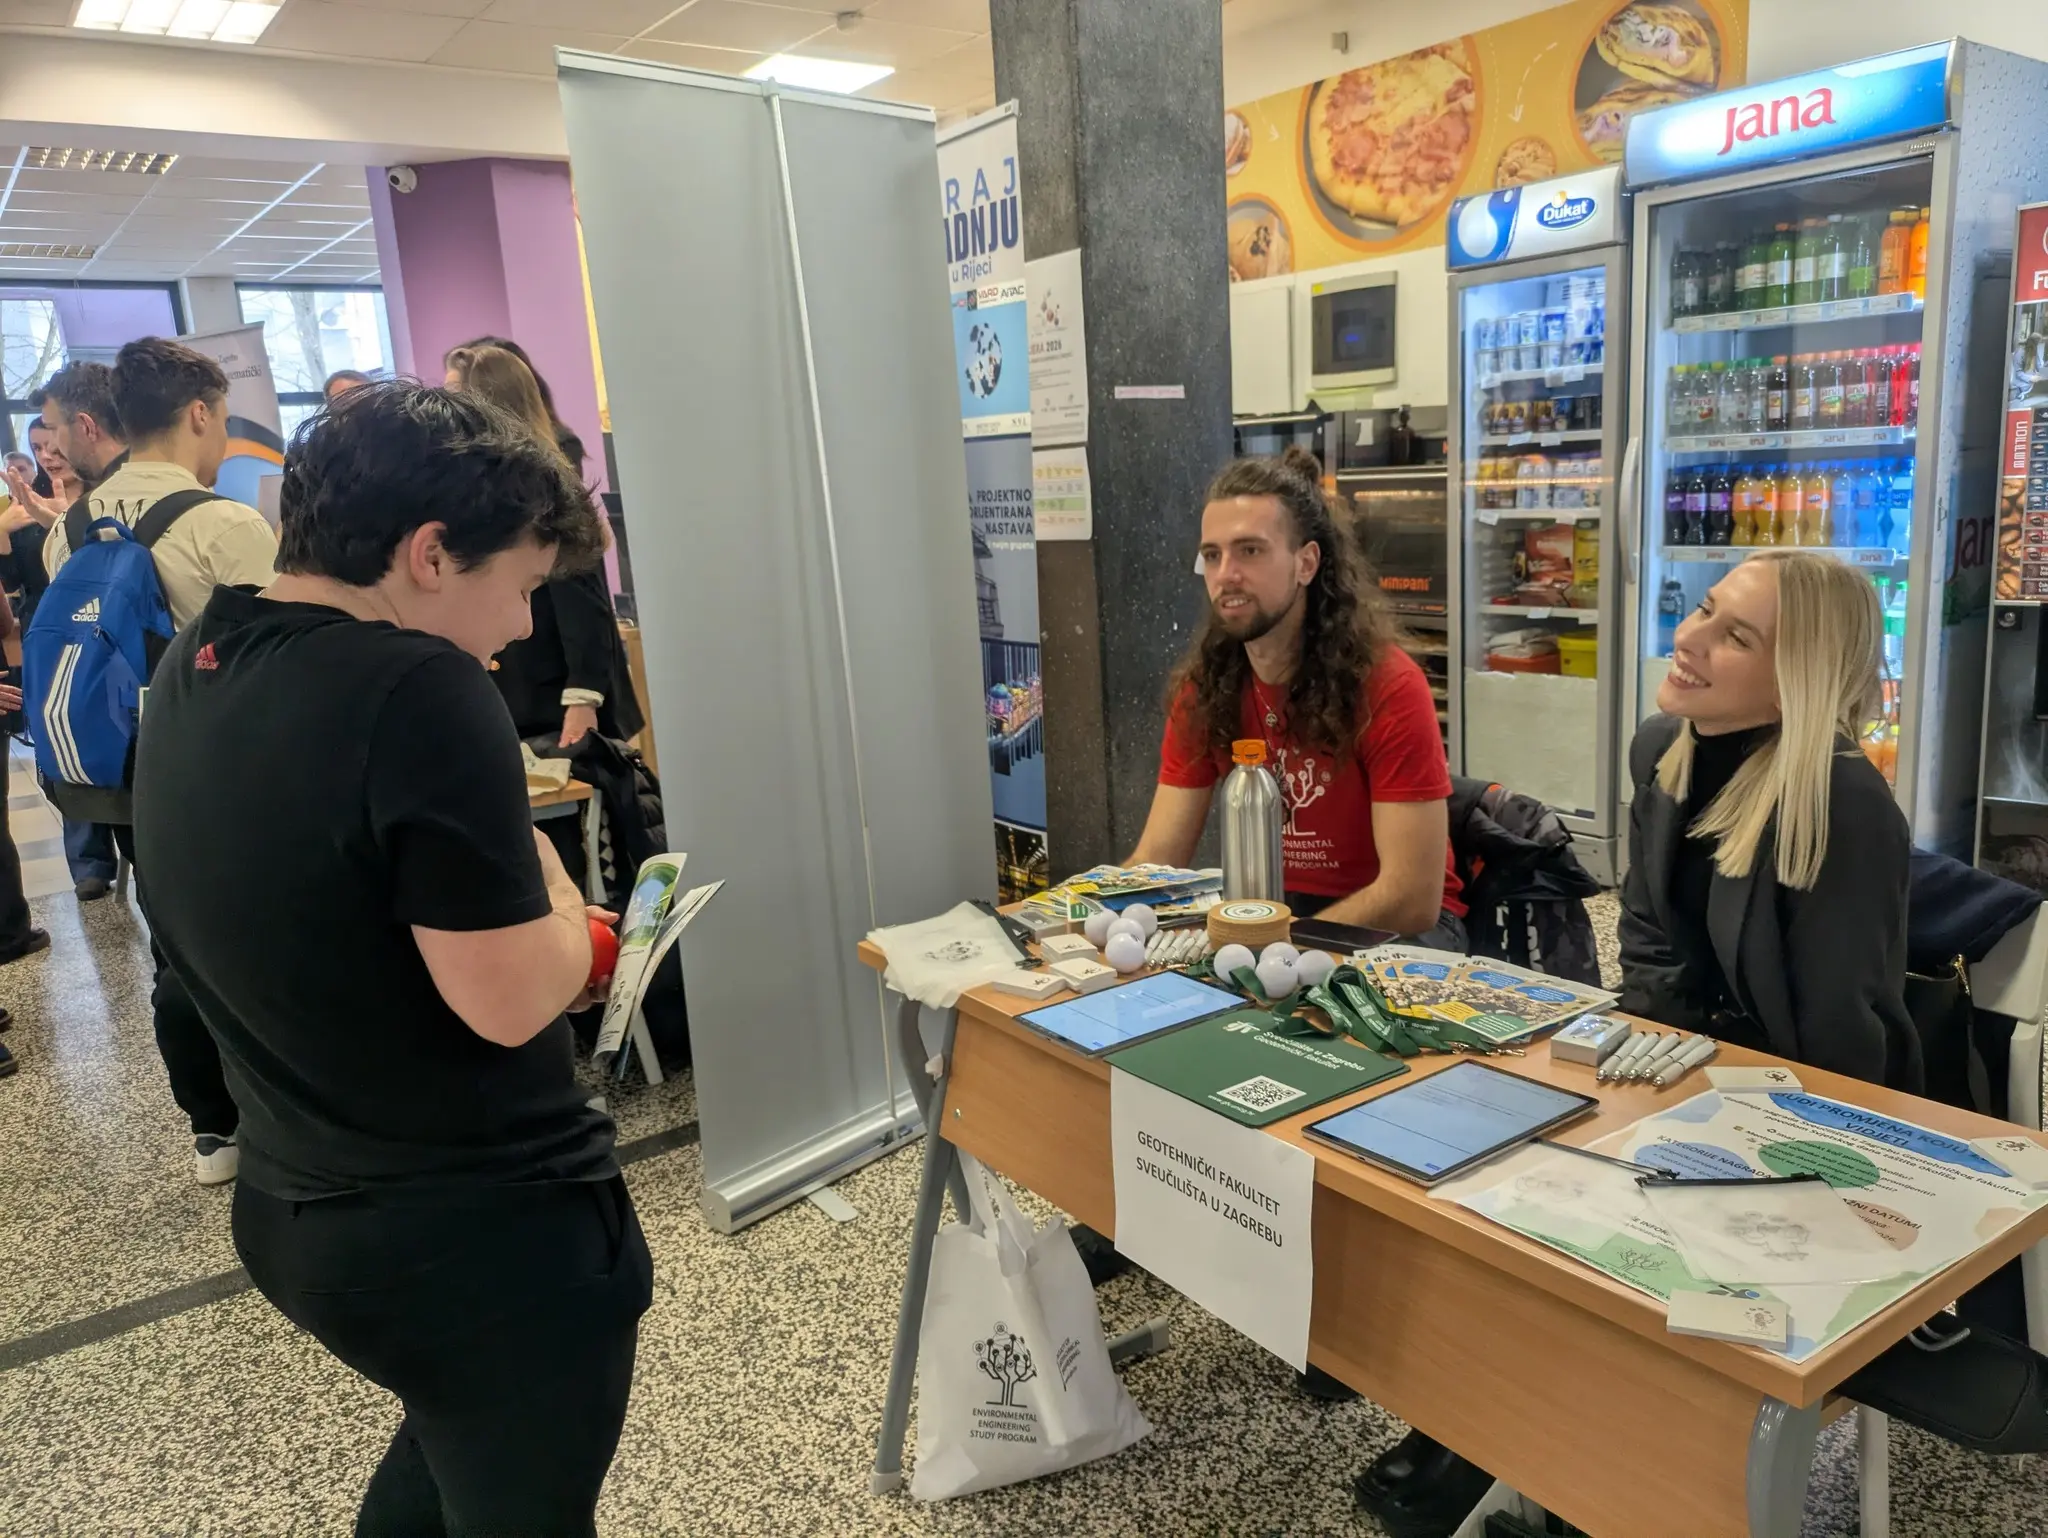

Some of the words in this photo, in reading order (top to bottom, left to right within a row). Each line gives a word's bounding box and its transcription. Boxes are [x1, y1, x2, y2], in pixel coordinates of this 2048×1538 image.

[1717, 88, 1836, 156] Jana
[1543, 200, 1588, 222] Dukat
[961, 257, 993, 283] Rijeci
[1355, 418, 1375, 447] 1
[976, 488, 1033, 502] PROJEKTNO
[985, 522, 1034, 536] NASTAVA
[1322, 1052, 1366, 1072] Zagrebu
[1818, 1104, 1913, 1137] PROMJENA
[1917, 1136, 1970, 1154] KOJU
[1845, 1122, 1909, 1147] VIDJETI
[1764, 1115, 1809, 1132] povodom
[1856, 1144, 1881, 1155] dana
[1918, 1165, 1957, 1180] okoliša
[1137, 1130, 1216, 1182] GEOTEHNIČKI
[1219, 1170, 1281, 1217] FAKULTET
[1718, 1157, 1772, 1179] NAGRADA
[1859, 1139, 1900, 1155] Zagrebu
[1902, 1152, 1975, 1180] Geotehničkog
[1976, 1177, 2028, 1197] fakulteta
[1136, 1156, 1208, 1207] SVEUČILIŠTA
[1211, 1195, 1220, 1212] U
[1223, 1202, 1283, 1248] ZAGREBU
[1868, 1208, 1923, 1230] DATUMI
[972, 1407, 1038, 1422] ENVIRONMENTAL
[978, 1419, 1031, 1432] ENGINEERING
[970, 1429, 995, 1440] STUDY
[997, 1433, 1037, 1444] PROGRAM
